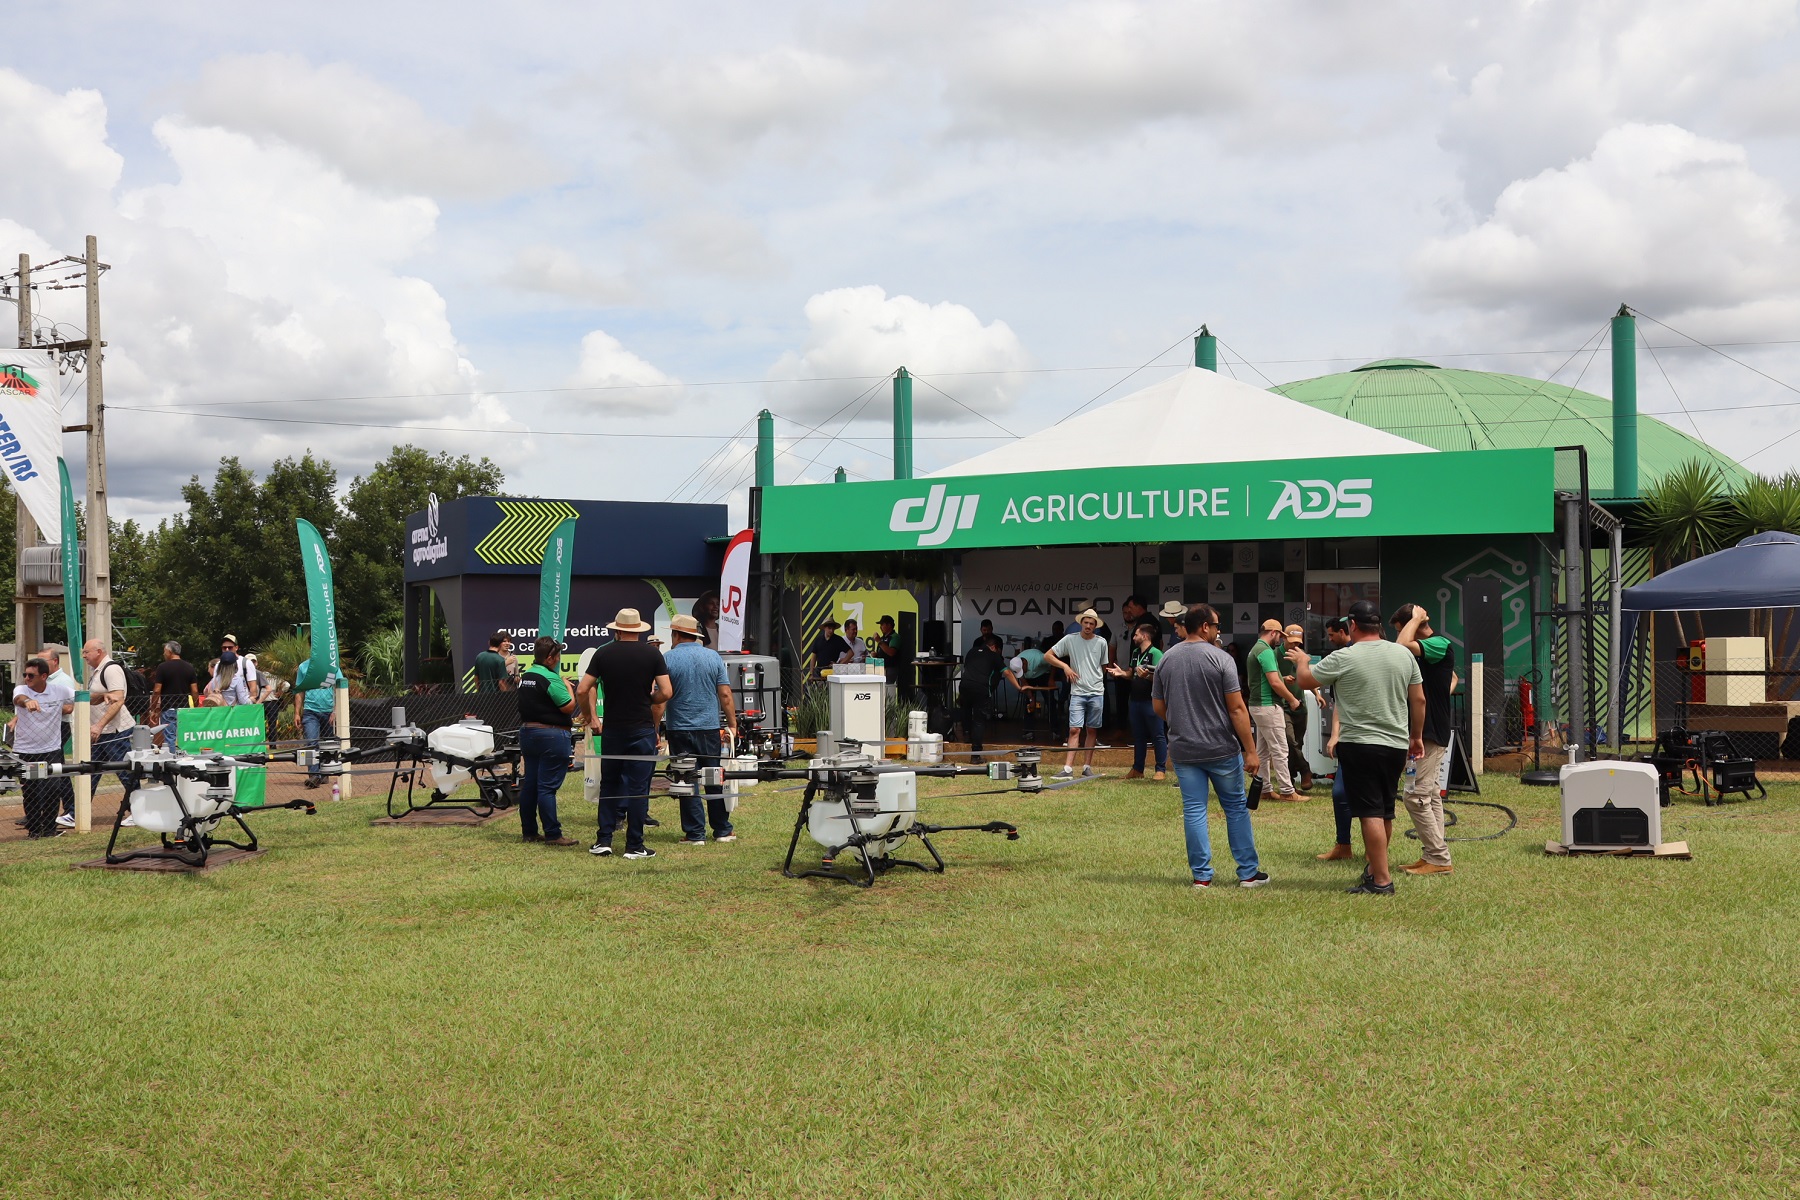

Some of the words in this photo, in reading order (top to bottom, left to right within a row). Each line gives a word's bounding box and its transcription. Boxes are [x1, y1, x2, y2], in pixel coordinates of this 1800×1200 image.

[1000, 487, 1230, 525] AGRICULTURE
[1267, 478, 1373, 520] ADS
[313, 543, 326, 574] ADS
[413, 536, 448, 567] agrodigital
[993, 581, 1041, 593] INOVAÇÃO
[1043, 582, 1064, 592] QUE
[1066, 582, 1099, 591] CHEGA
[1163, 585, 1180, 593] ADS
[322, 583, 337, 668] AGRICULTURE
[853, 693, 871, 701] ADS
[183, 729, 223, 742] FLYING
[225, 726, 260, 739] ARENA
